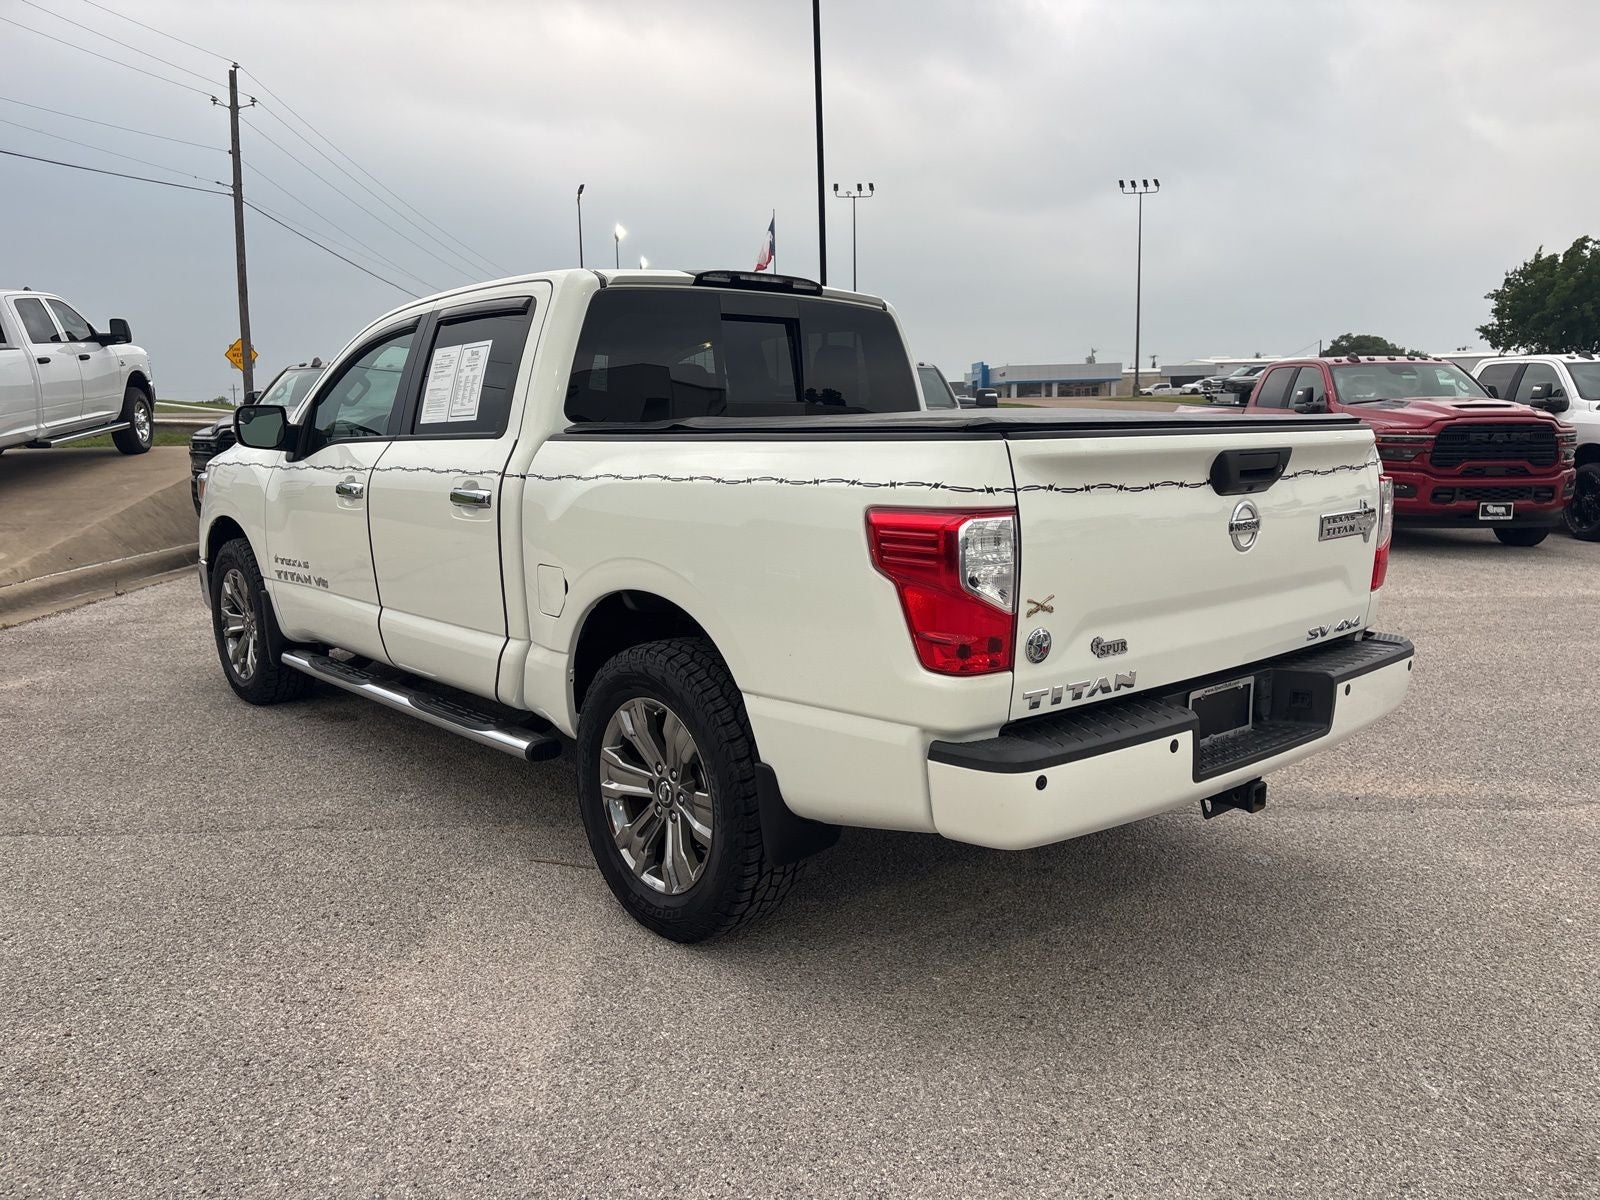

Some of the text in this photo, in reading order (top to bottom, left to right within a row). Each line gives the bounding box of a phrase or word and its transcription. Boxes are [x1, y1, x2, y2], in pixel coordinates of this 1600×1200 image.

[1234, 520, 1259, 531] NISSAN
[1326, 515, 1356, 525] TEXAS
[1326, 524, 1355, 536] TITAN
[278, 557, 309, 569] TEXAS
[275, 569, 312, 585] TITAN
[1306, 624, 1331, 641] SV
[1101, 640, 1128, 656] SPUR
[1022, 670, 1137, 710] TITAN
